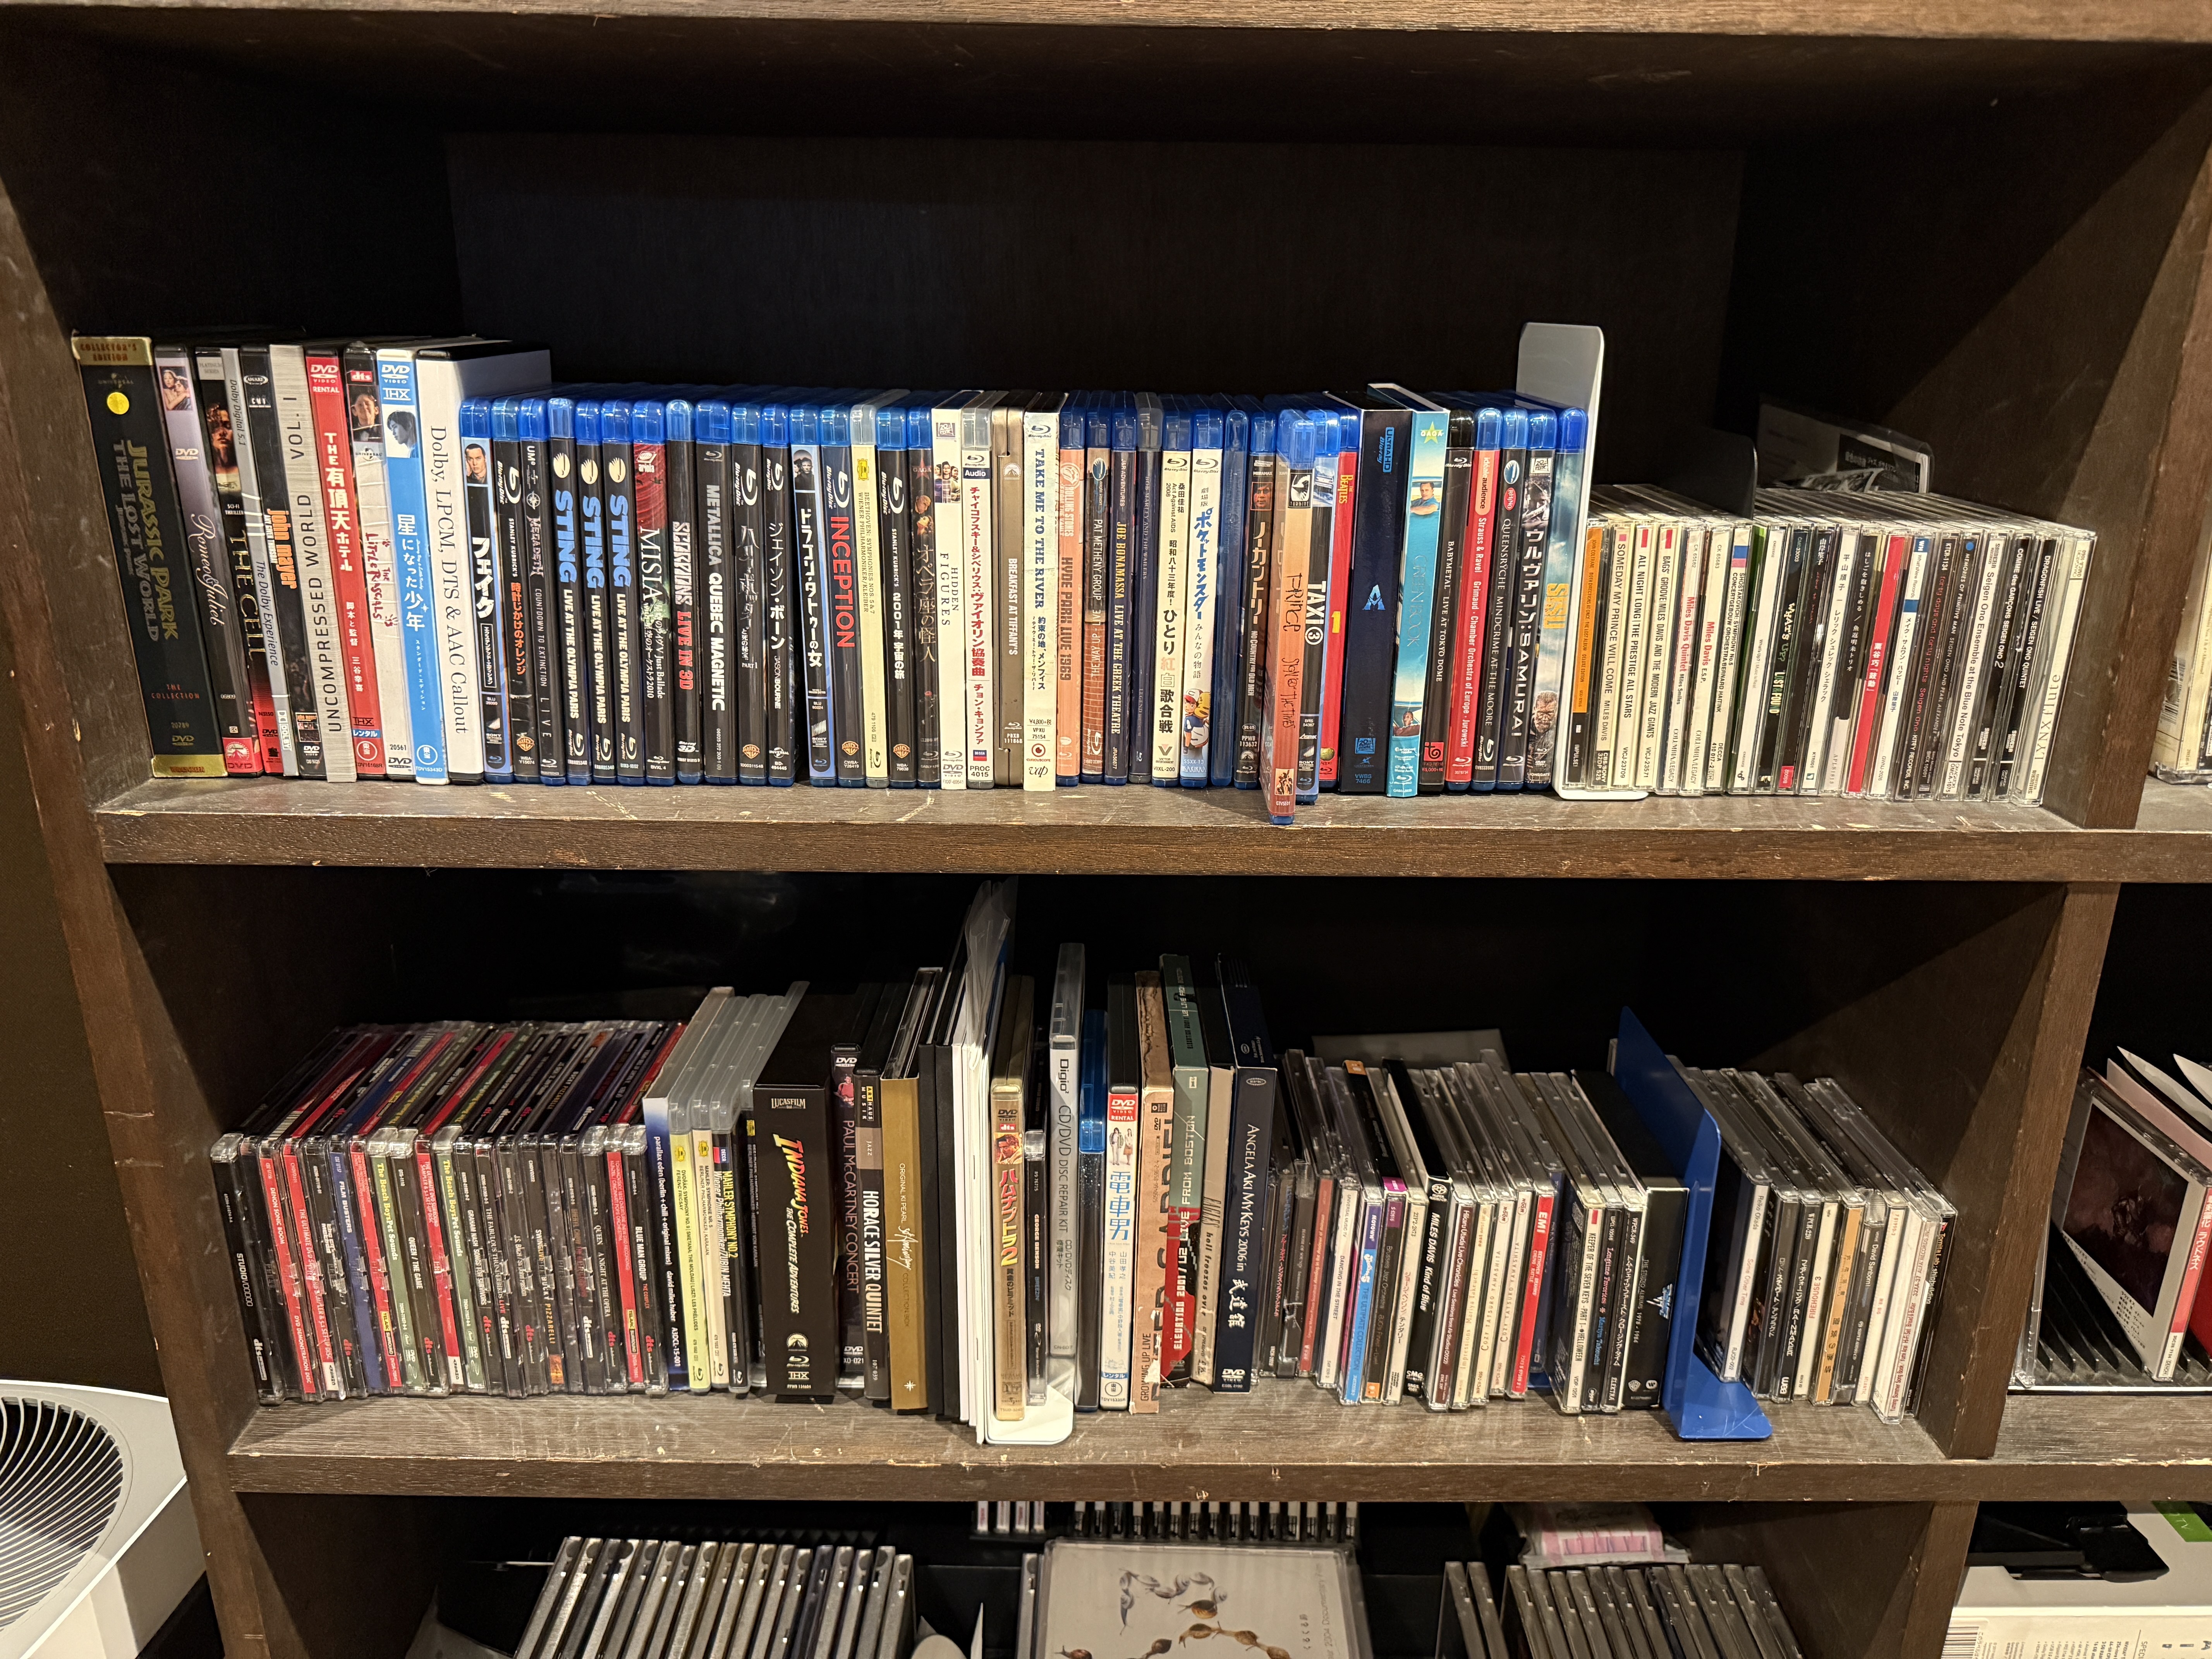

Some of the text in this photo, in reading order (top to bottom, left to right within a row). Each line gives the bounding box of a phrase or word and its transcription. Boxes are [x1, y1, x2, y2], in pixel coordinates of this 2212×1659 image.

[234, 404, 244, 433] Digital
[127, 440, 179, 640] JURASSIC PARK
[267, 509, 297, 589] john mayer
[326, 468, 352, 571] 有頂天ホテル
[526, 516, 544, 578] MEGADETH
[555, 490, 577, 583] STING
[583, 496, 605, 588] STING
[610, 495, 631, 587] STING
[1036, 449, 1044, 609] TAKE ME TO THE RIVER
[230, 530, 266, 661] THE CELL
[289, 414, 342, 732] UNCOMPRESSED WORLD VOL.
[397, 514, 425, 632] 星になった少年
[431, 426, 468, 733] Dolby, LPCM, DTS & AAC Callout
[639, 527, 663, 601] MISIA
[706, 485, 725, 711] METALLICA QUEBEC MAGNETIC
[769, 523, 785, 649] ジェイソン・ボーン
[801, 508, 822, 667] ドラゴン・タトゥーの女
[831, 517, 855, 647] INCEPTION
[940, 553, 950, 625] FIGURES
[1092, 519, 1103, 601] PAT METHENY GROUP
[1115, 522, 1127, 599] JOE BONAMASSA
[1194, 507, 1214, 620] ポケットモンスター
[1250, 522, 1266, 624] ノーカントリー
[1444, 542, 1455, 589] BABYMETAL
[1471, 517, 1486, 614] Strauss Ravel Grimaud
[1614, 544, 1625, 589] SOMEDAY
[1614, 591, 1621, 606] MY
[1636, 572, 1645, 596] NIGHT
[1857, 552, 1871, 611] はしごを抱きしめる
[256, 562, 278, 666] The Dolby Experience
[511, 582, 526, 675] 時計じかけのオレンジ
[535, 589, 547, 686] COUNTDOWN EXTINCTION
[1008, 558, 1018, 655] BREAKFAST TIFFANY'S
[1060, 558, 1073, 680] HYDE PARK LIVE 1969
[1163, 610, 1177, 655] ひとり
[1305, 581, 1326, 625] TAXI
[1492, 596, 1505, 654] MINDCRIME
[1543, 584, 1569, 629] SISU
[1610, 608, 1620, 641] PRINCE
[1680, 597, 1695, 672] Miles Davis Quintet
[2019, 555, 2051, 688] DRAGONFISH QUINTET
[346, 602, 363, 692] 脚本と監督 三谷幸喜
[563, 590, 579, 719] LIVE OLYMPIA PARIS
[677, 611, 693, 690] LIVE 3D
[1038, 617, 1046, 690] 約束の地、メンフィス
[1112, 603, 1123, 734] LIVE GREEK THEATRE
[1439, 631, 1447, 659] TOKYO
[1511, 633, 1531, 736] SAMURAI
[1604, 668, 1614, 694] COME
[1607, 642, 1616, 666] WILL
[1953, 572, 1994, 757] Seigen Ono Ensemble Tokyo
[1601, 701, 1610, 720] MILES
[2035, 674, 2060, 761] LYNX flute
[771, 1098, 805, 1109] LUCASFILM
[1059, 1106, 1071, 1233] CD/DVD DISC REPAIR KIT
[1182, 1116, 1195, 1204] BOSTON FROM
[342, 1200, 352, 1233] BUSTERS
[723, 1171, 736, 1239] MAHLER SYMPHONY
[843, 1120, 859, 1293] PAUL CONCERT
[999, 1169, 1018, 1267] ハムナプトラ2
[1109, 1171, 1131, 1240] 電車男
[1537, 1211, 1547, 1233] EMI
[237, 1253, 253, 1307] STUDIOVOODOO
[388, 1234, 397, 1261] Sounds
[415, 1273, 423, 1289] GAME
[639, 1259, 647, 1280] GROUP
[787, 1221, 800, 1314] COMPLETE ADVENTURES
[863, 1190, 882, 1333] HORACE SILVER QUINTET
[1420, 1212, 1440, 1311] MILES DAVIS Kind Blue
[2189, 1233, 2208, 1271] ラウドネス
[1227, 1279, 1249, 1328] 武道館
[1809, 1281, 1820, 1319] FIREHOUSE
[295, 1328, 310, 1370] DEMONSTRATION
[1575, 1333, 1585, 1361] HELLOWEEN
[1609, 1377, 1618, 1401] ELEKTRA
